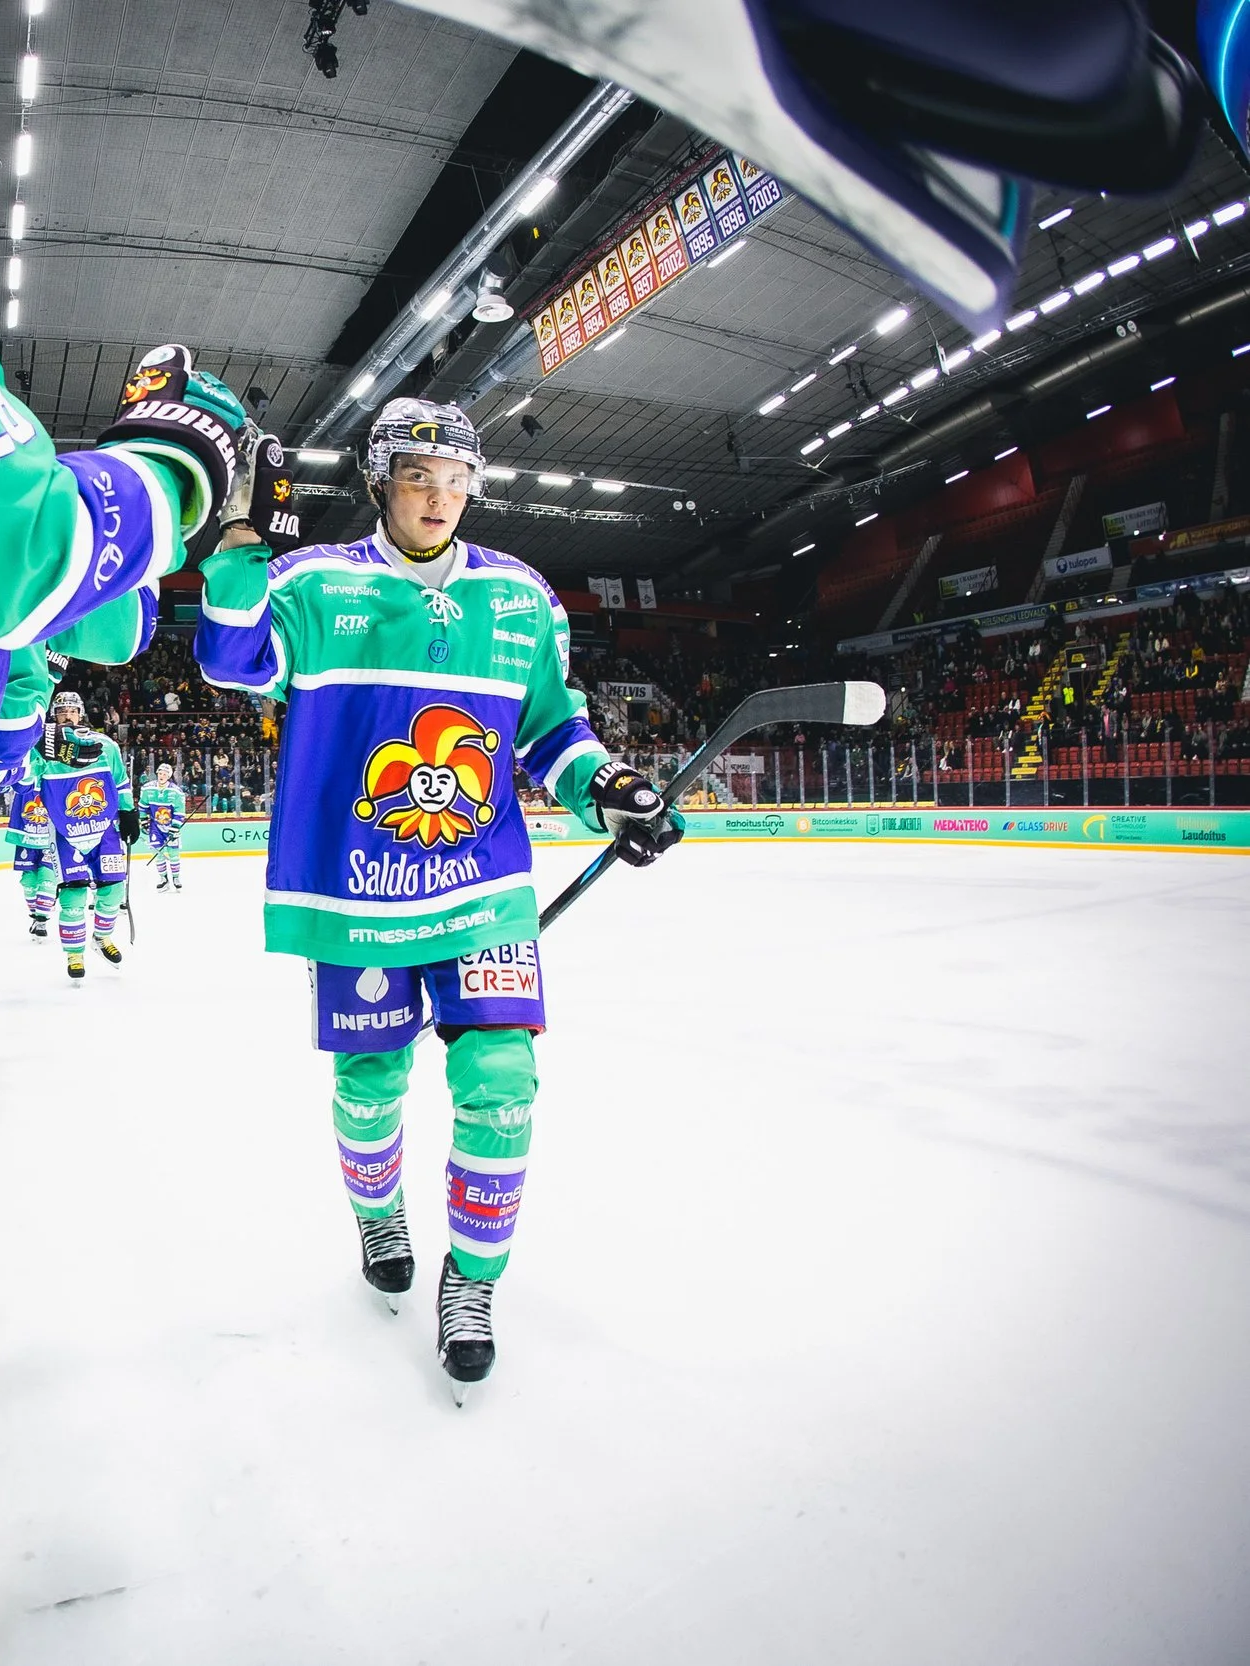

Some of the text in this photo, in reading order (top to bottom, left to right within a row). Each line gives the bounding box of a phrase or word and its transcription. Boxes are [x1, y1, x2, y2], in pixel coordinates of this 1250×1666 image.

[749, 180, 780, 216] 2003
[718, 205, 746, 238] 1996
[689, 228, 715, 259] 1995
[657, 249, 685, 281] 2002
[633, 271, 654, 300] 1997
[609, 291, 629, 319] 1996
[584, 312, 604, 338] 1994
[563, 331, 583, 356] 1992
[543, 346, 559, 371] 1973
[1069, 556, 1097, 570] tulopos
[334, 614, 370, 630] RTK
[981, 612, 1015, 627] HELSINGIN
[609, 685, 647, 698] HELVIS
[66, 818, 112, 837] Saldo Bank
[812, 817, 858, 826] Bitcoinkeskus
[933, 819, 988, 832] MEDIATEKO
[1017, 821, 1068, 832] GLASSDRIVE
[1111, 815, 1147, 823] CREATIVE
[1182, 830, 1226, 842] Laudoitus
[348, 849, 420, 897] Saldo
[464, 969, 536, 993] CREW
[332, 1005, 414, 1032] INFUEL
